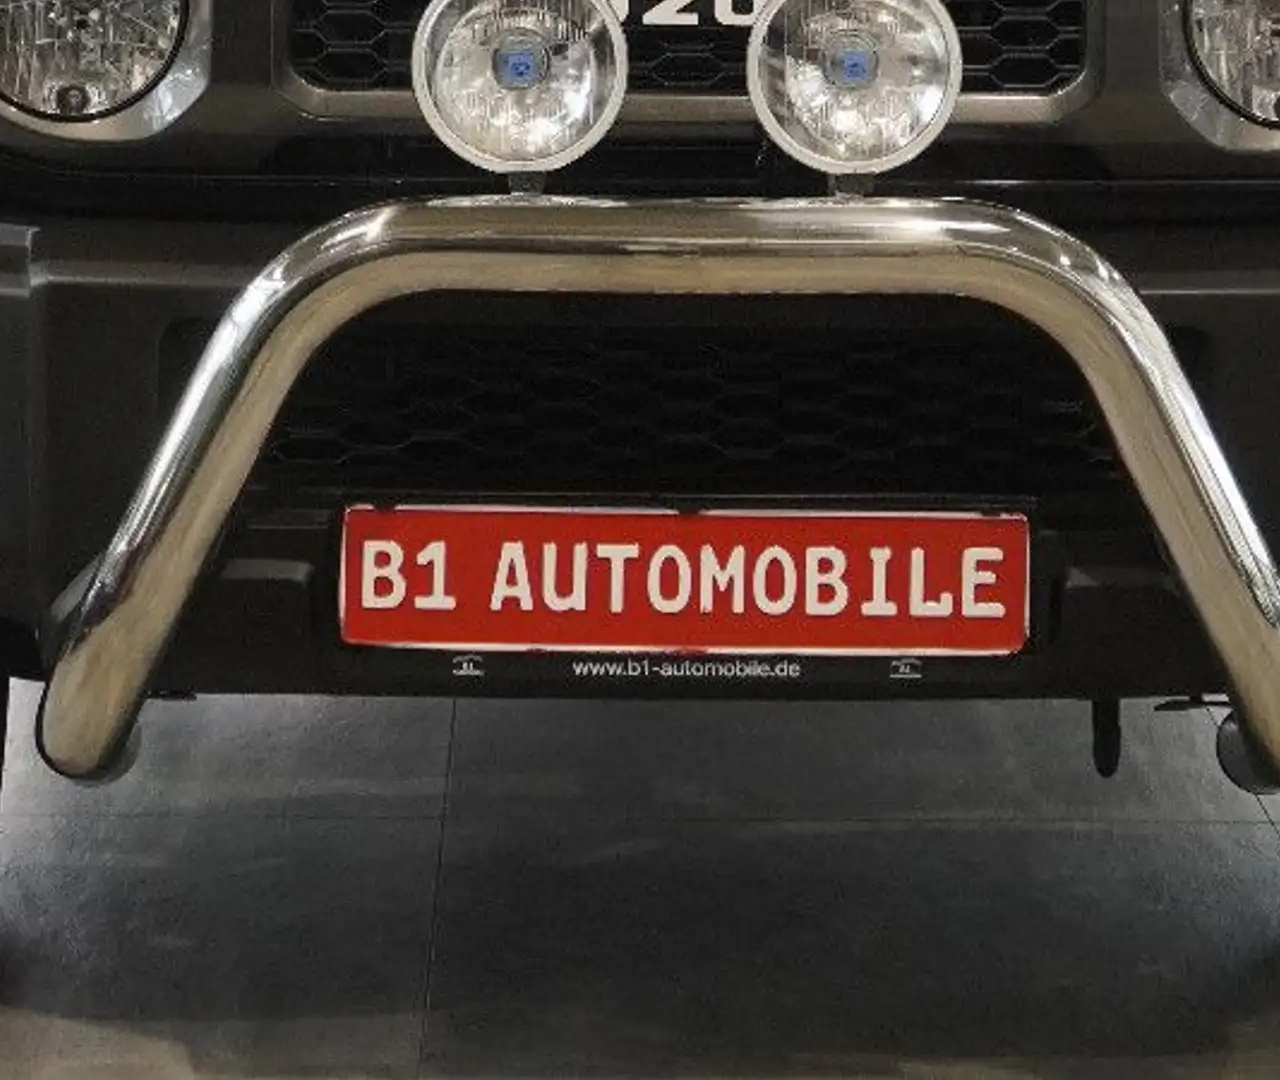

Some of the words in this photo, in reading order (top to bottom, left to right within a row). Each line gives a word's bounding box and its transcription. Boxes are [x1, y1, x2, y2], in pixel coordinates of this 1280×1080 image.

[360, 539, 457, 610] B1
[489, 540, 1006, 617] AUTOMOBILE
[572, 658, 801, 677] www.b1-automobile.de
